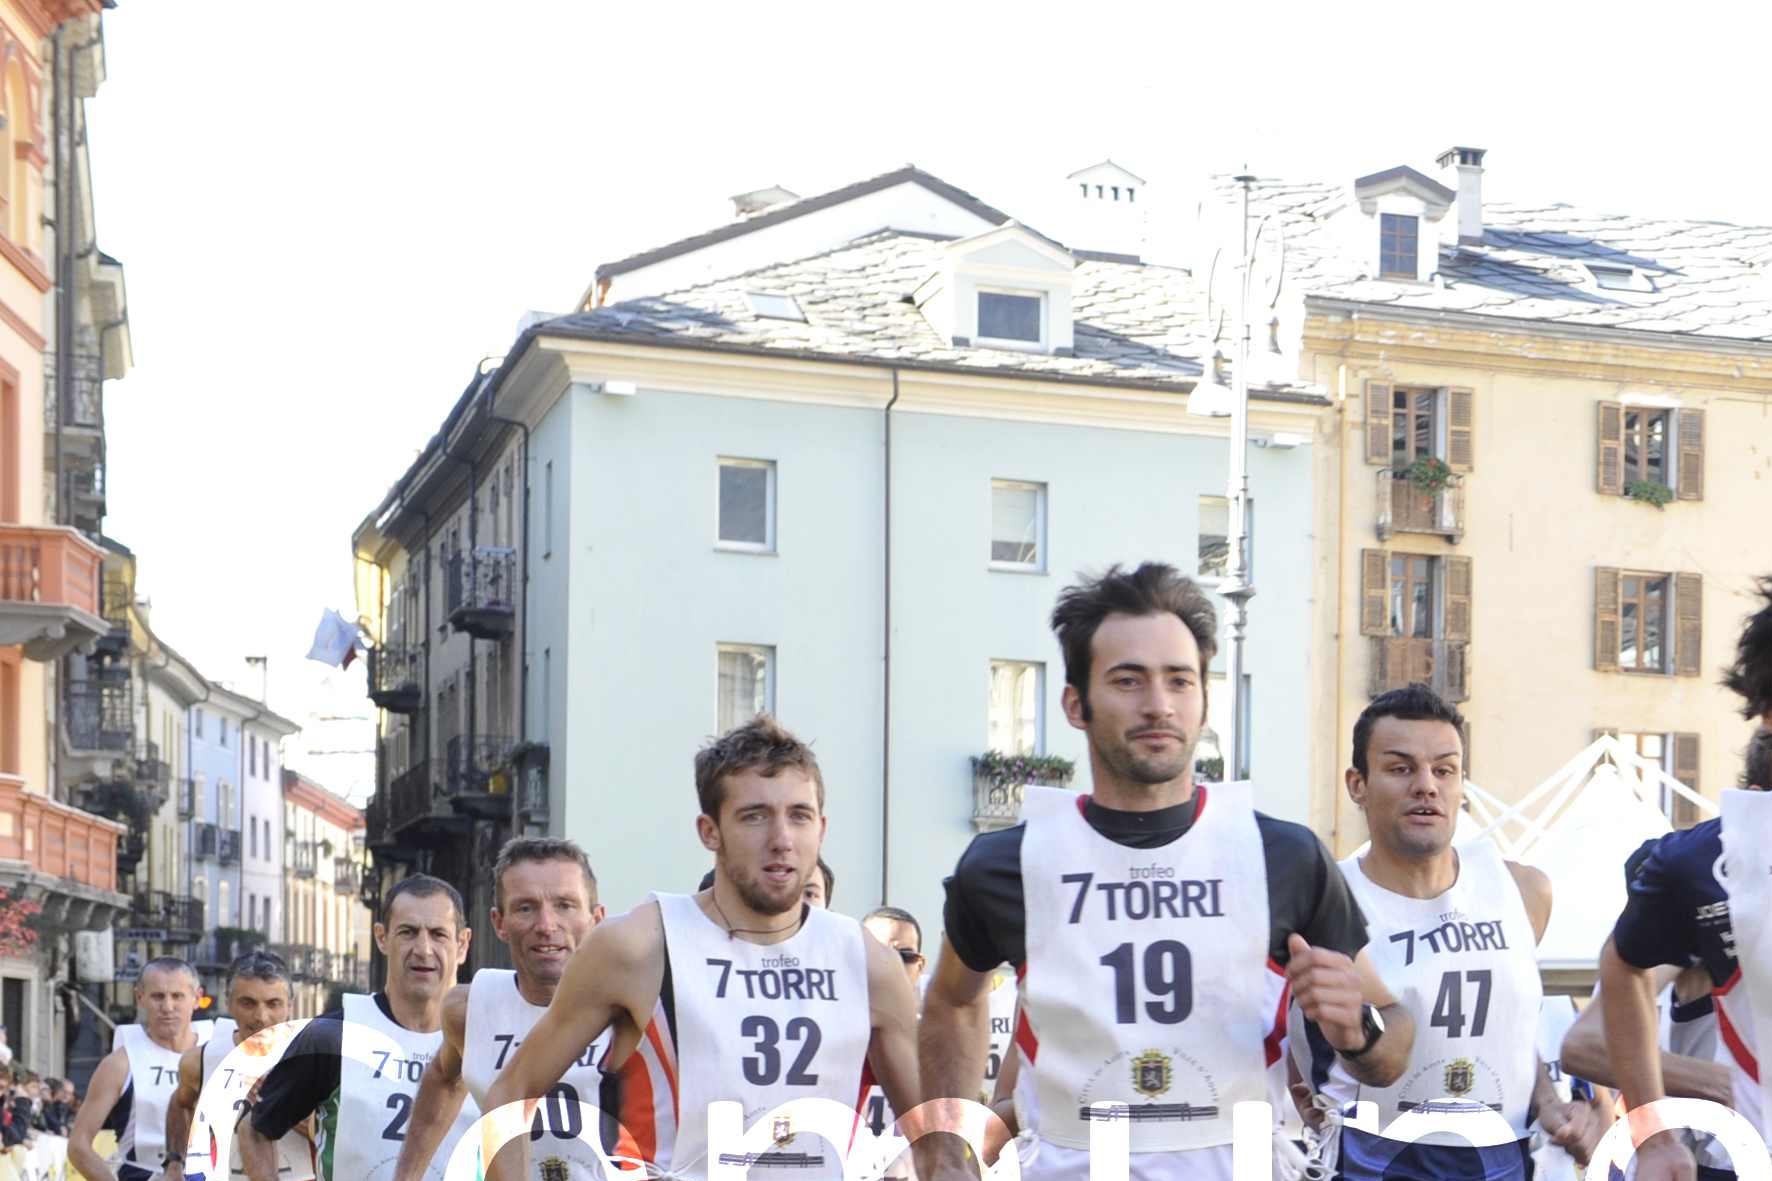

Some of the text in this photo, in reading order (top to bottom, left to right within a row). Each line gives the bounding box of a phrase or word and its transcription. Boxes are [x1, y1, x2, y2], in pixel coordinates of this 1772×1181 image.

[1130, 863, 1175, 879] trofeo
[1061, 872, 1225, 924] 7 TORRI
[761, 954, 800, 968] trofeo
[1389, 920, 1510, 966] 7 TORRI
[706, 958, 839, 1001] 7 TORRI
[1100, 940, 1193, 1025] 19
[1430, 969, 1493, 1038] 47
[372, 1050, 391, 1079] 7
[494, 1034, 515, 1070] 7
[741, 1015, 822, 1087] 32
